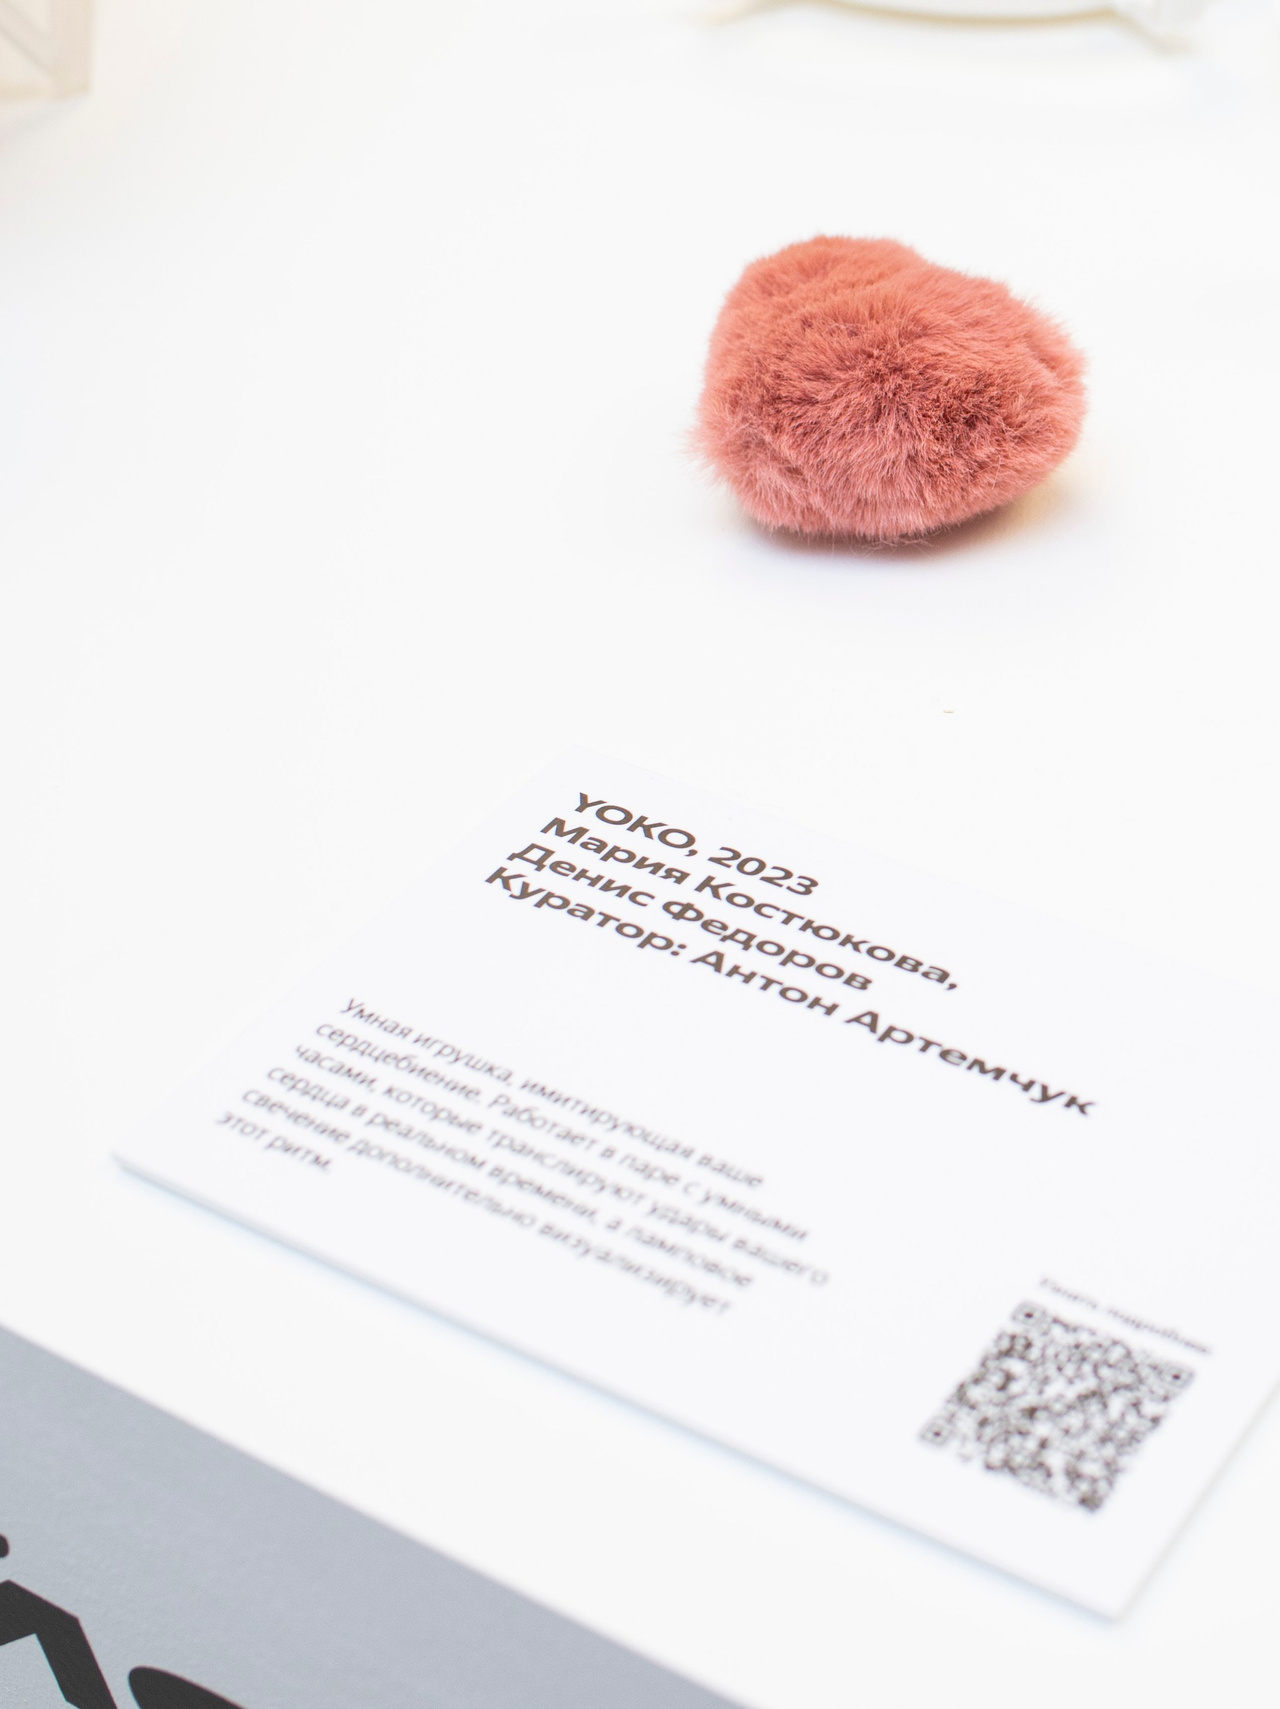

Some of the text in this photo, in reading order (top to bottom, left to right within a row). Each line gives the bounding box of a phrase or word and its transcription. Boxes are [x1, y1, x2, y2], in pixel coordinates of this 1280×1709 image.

[541, 816, 958, 991] Мария Костюкова,
[575, 792, 819, 897] YOKO, 2023
[507, 842, 873, 991] Денис Федоров
[485, 866, 1096, 1115] Куратор: Антон Артемчук
[216, 1112, 269, 1140] этот
[242, 1089, 351, 1144] свечение
[267, 1067, 351, 1111] сердца
[352, 1104, 368, 1118] в
[365, 1112, 487, 1170] реальном
[296, 1044, 379, 1092] часами,
[384, 1085, 483, 1136] которые
[487, 1129, 647, 1205] транслируют
[340, 997, 764, 1188] Умная игрушка, имитирующая ваше
[487, 1093, 599, 1150] Работает
[600, 1146, 617, 1160] в
[619, 1153, 681, 1186] паре
[683, 1180, 700, 1196] с
